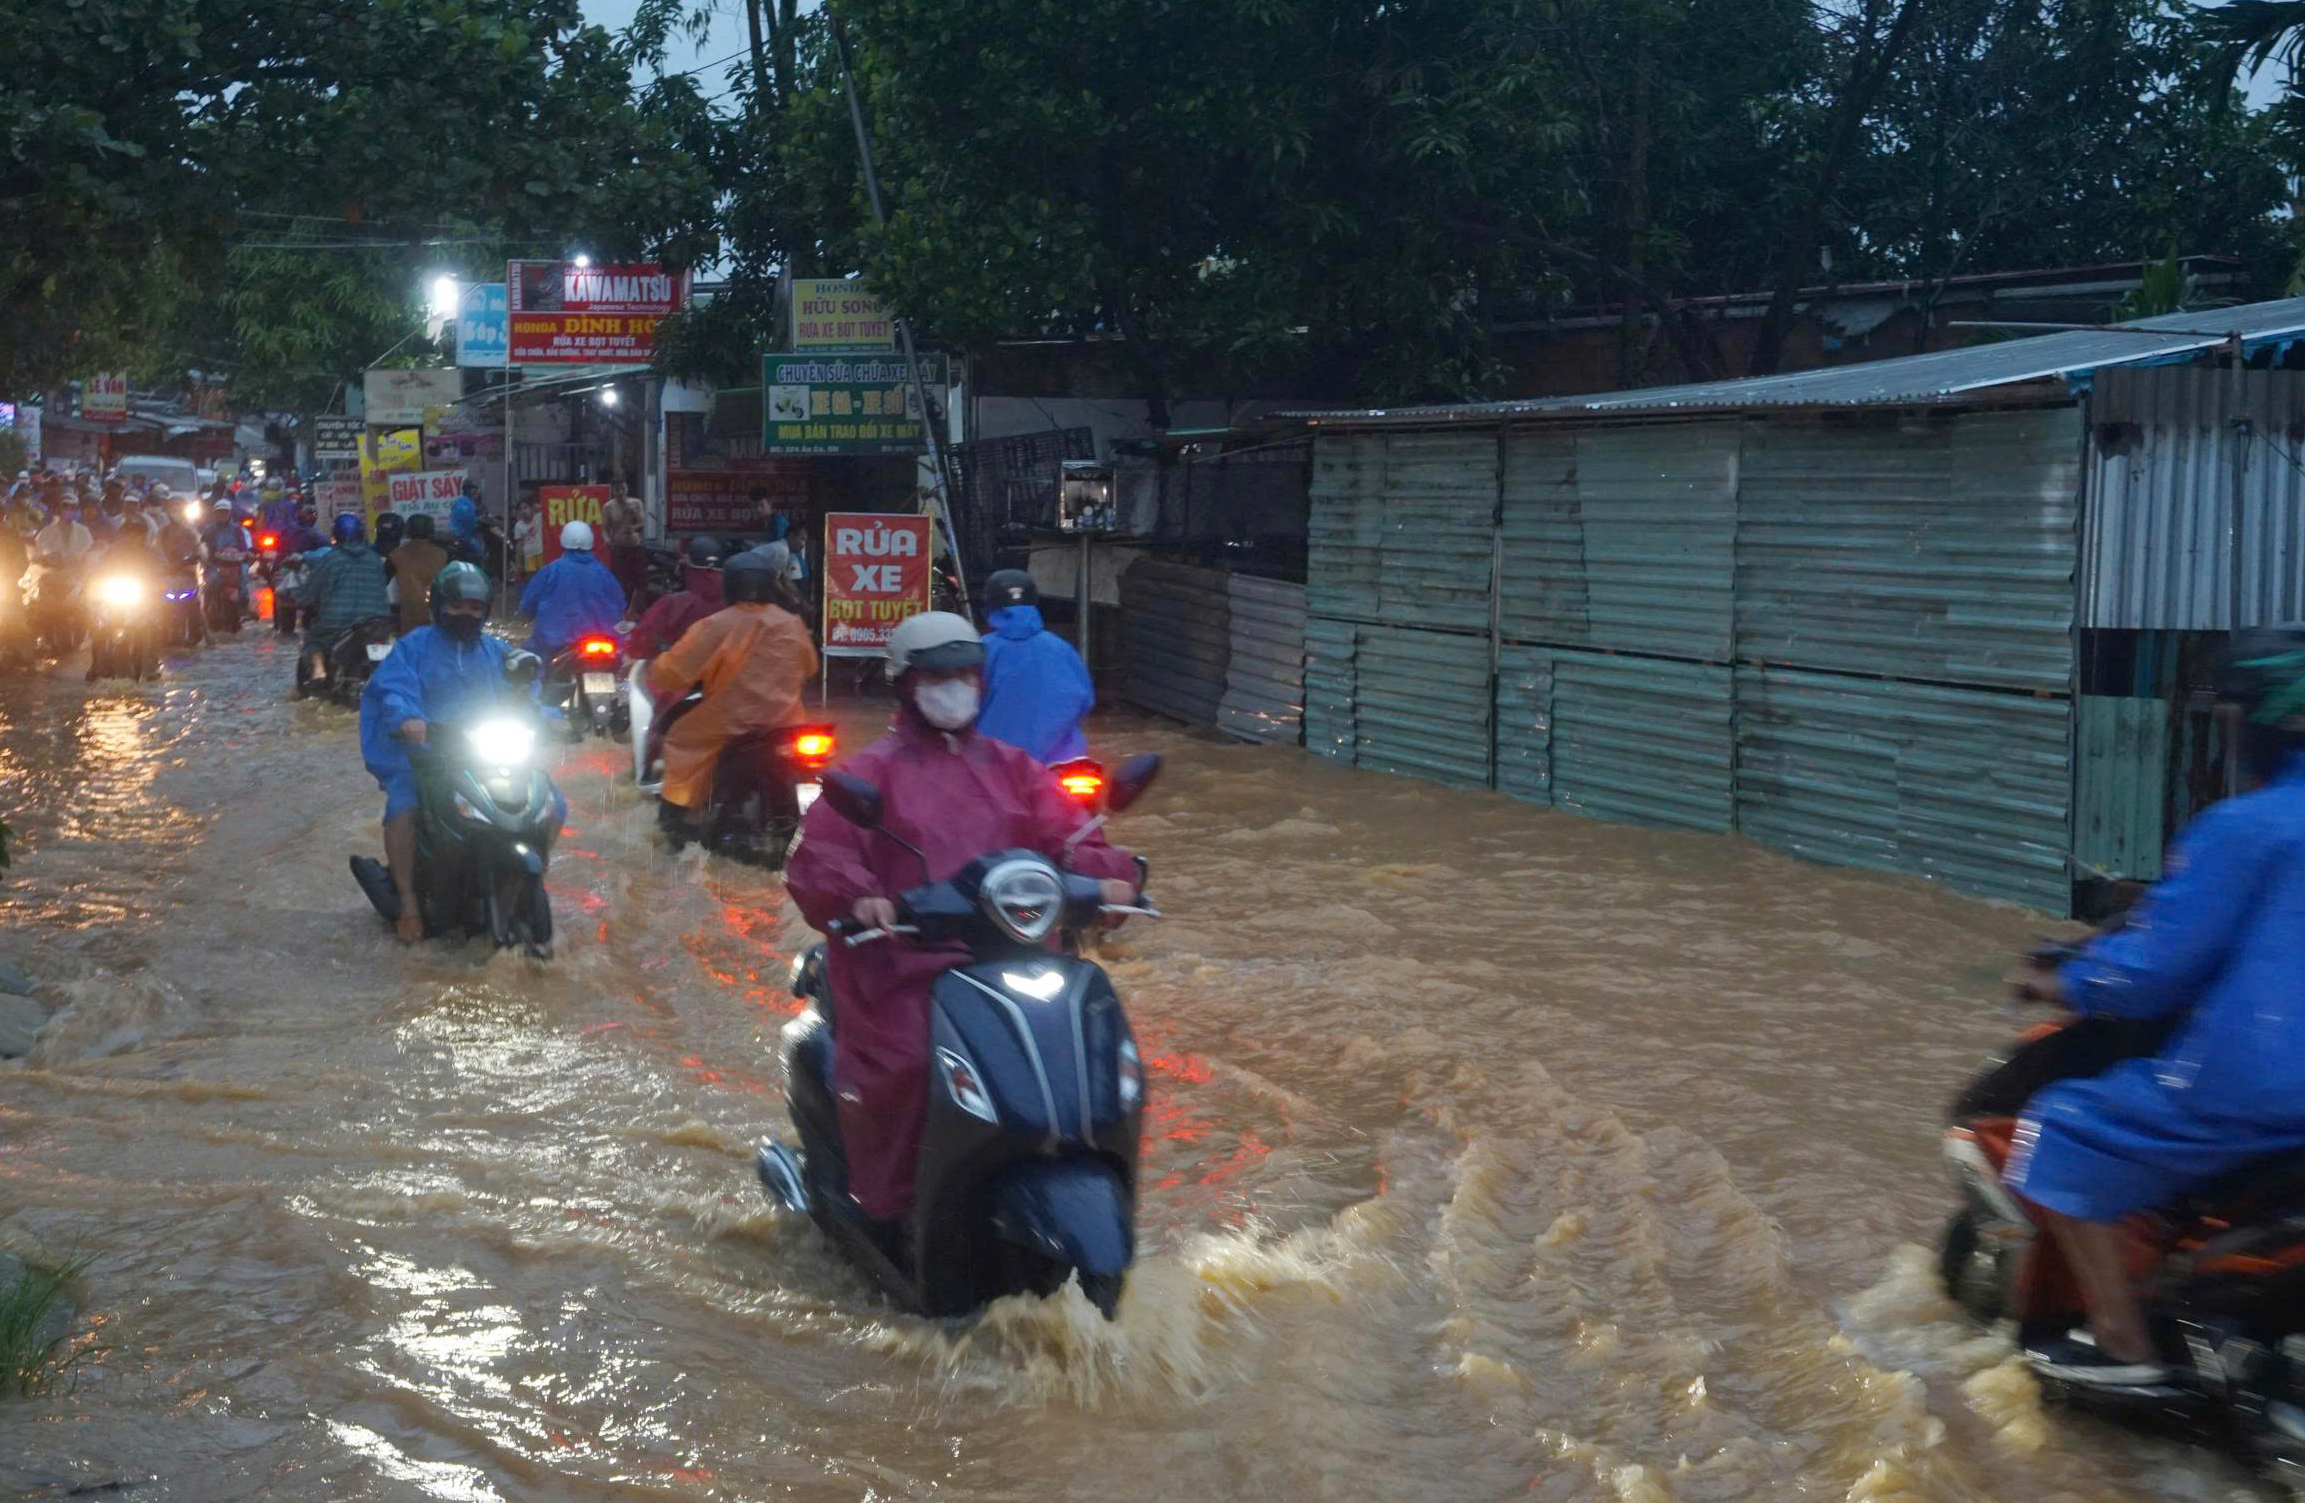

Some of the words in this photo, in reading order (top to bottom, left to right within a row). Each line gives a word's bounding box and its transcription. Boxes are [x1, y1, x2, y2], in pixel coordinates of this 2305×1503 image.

[564, 274, 672, 303] KAWAMATSU
[815, 284, 864, 294] HOND
[514, 321, 557, 334] HONDA
[564, 313, 621, 335] ĐÌNH
[777, 359, 826, 383] CHUYÊN
[827, 358, 851, 383] SỬA
[854, 359, 888, 383] CHỮA
[889, 364, 907, 383] XE
[811, 390, 831, 414] XE
[862, 390, 883, 414] XE
[777, 425, 802, 438] MUA
[805, 421, 828, 438] BÁN
[829, 425, 856, 438] TRAO
[879, 425, 895, 438] XE
[431, 470, 463, 498] SẤY
[548, 488, 601, 527] RỬA
[836, 520, 917, 557] RỬA
[850, 564, 903, 592] XE
[830, 599, 863, 621] BỌT
